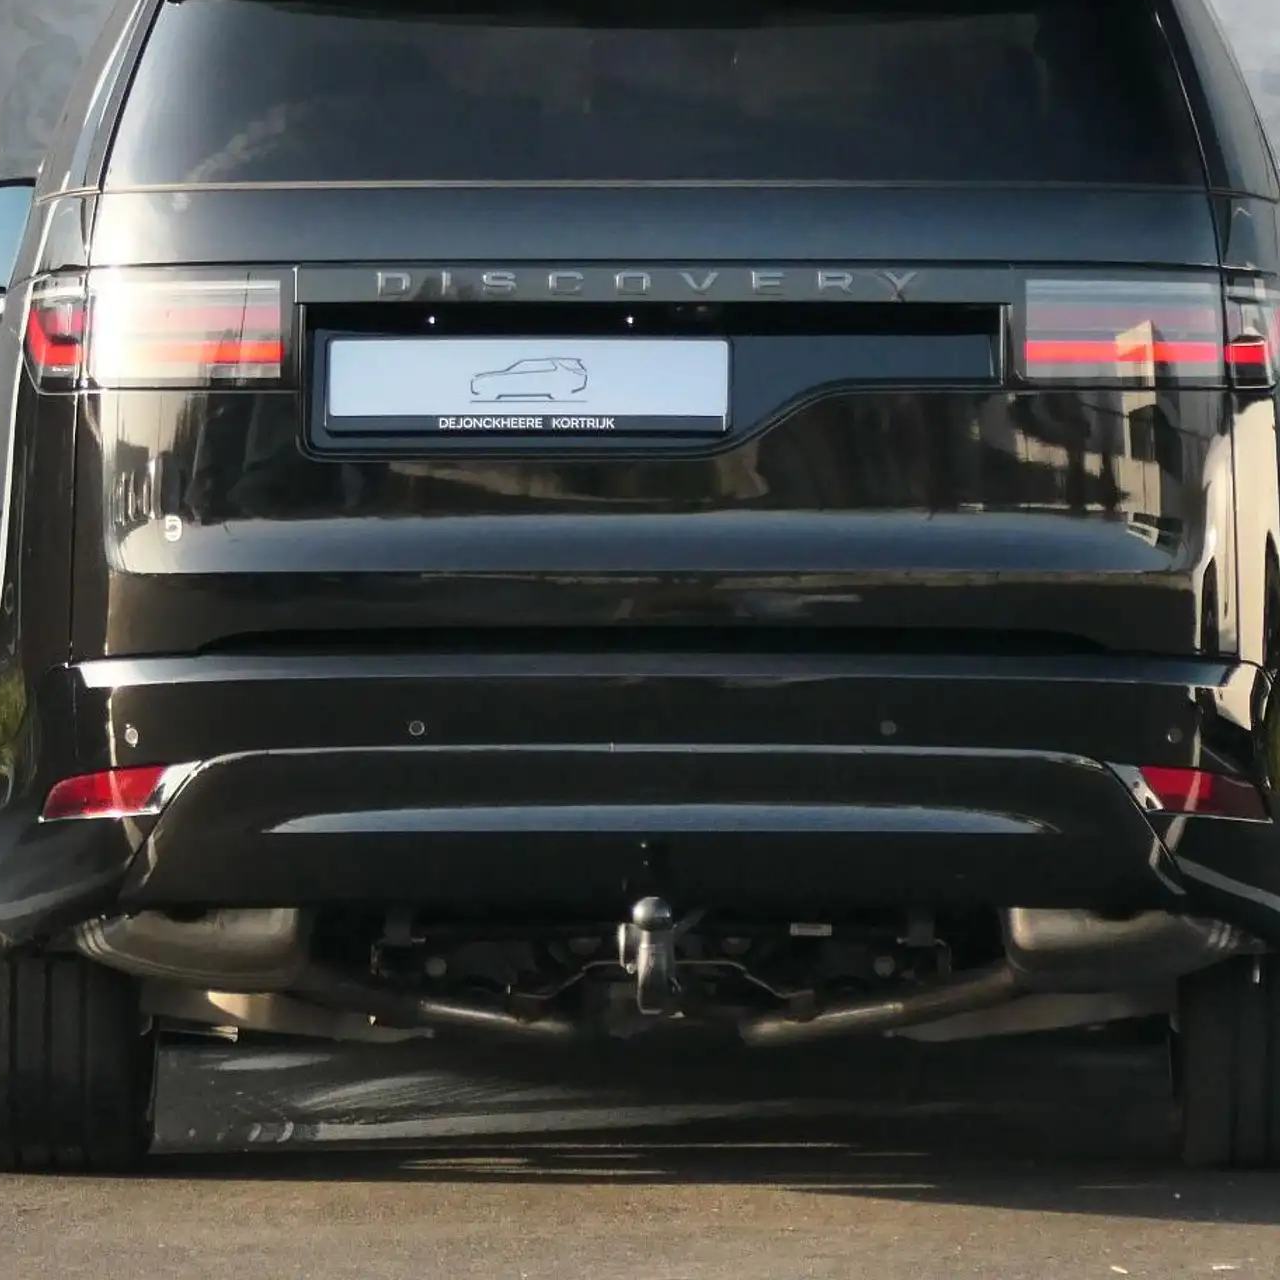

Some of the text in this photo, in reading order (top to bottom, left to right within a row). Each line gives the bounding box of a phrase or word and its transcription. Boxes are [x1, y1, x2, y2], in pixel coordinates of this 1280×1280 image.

[376, 271, 919, 296] DISCOVERY
[438, 416, 615, 429] DEJONCKHEERE KORTRIJK
